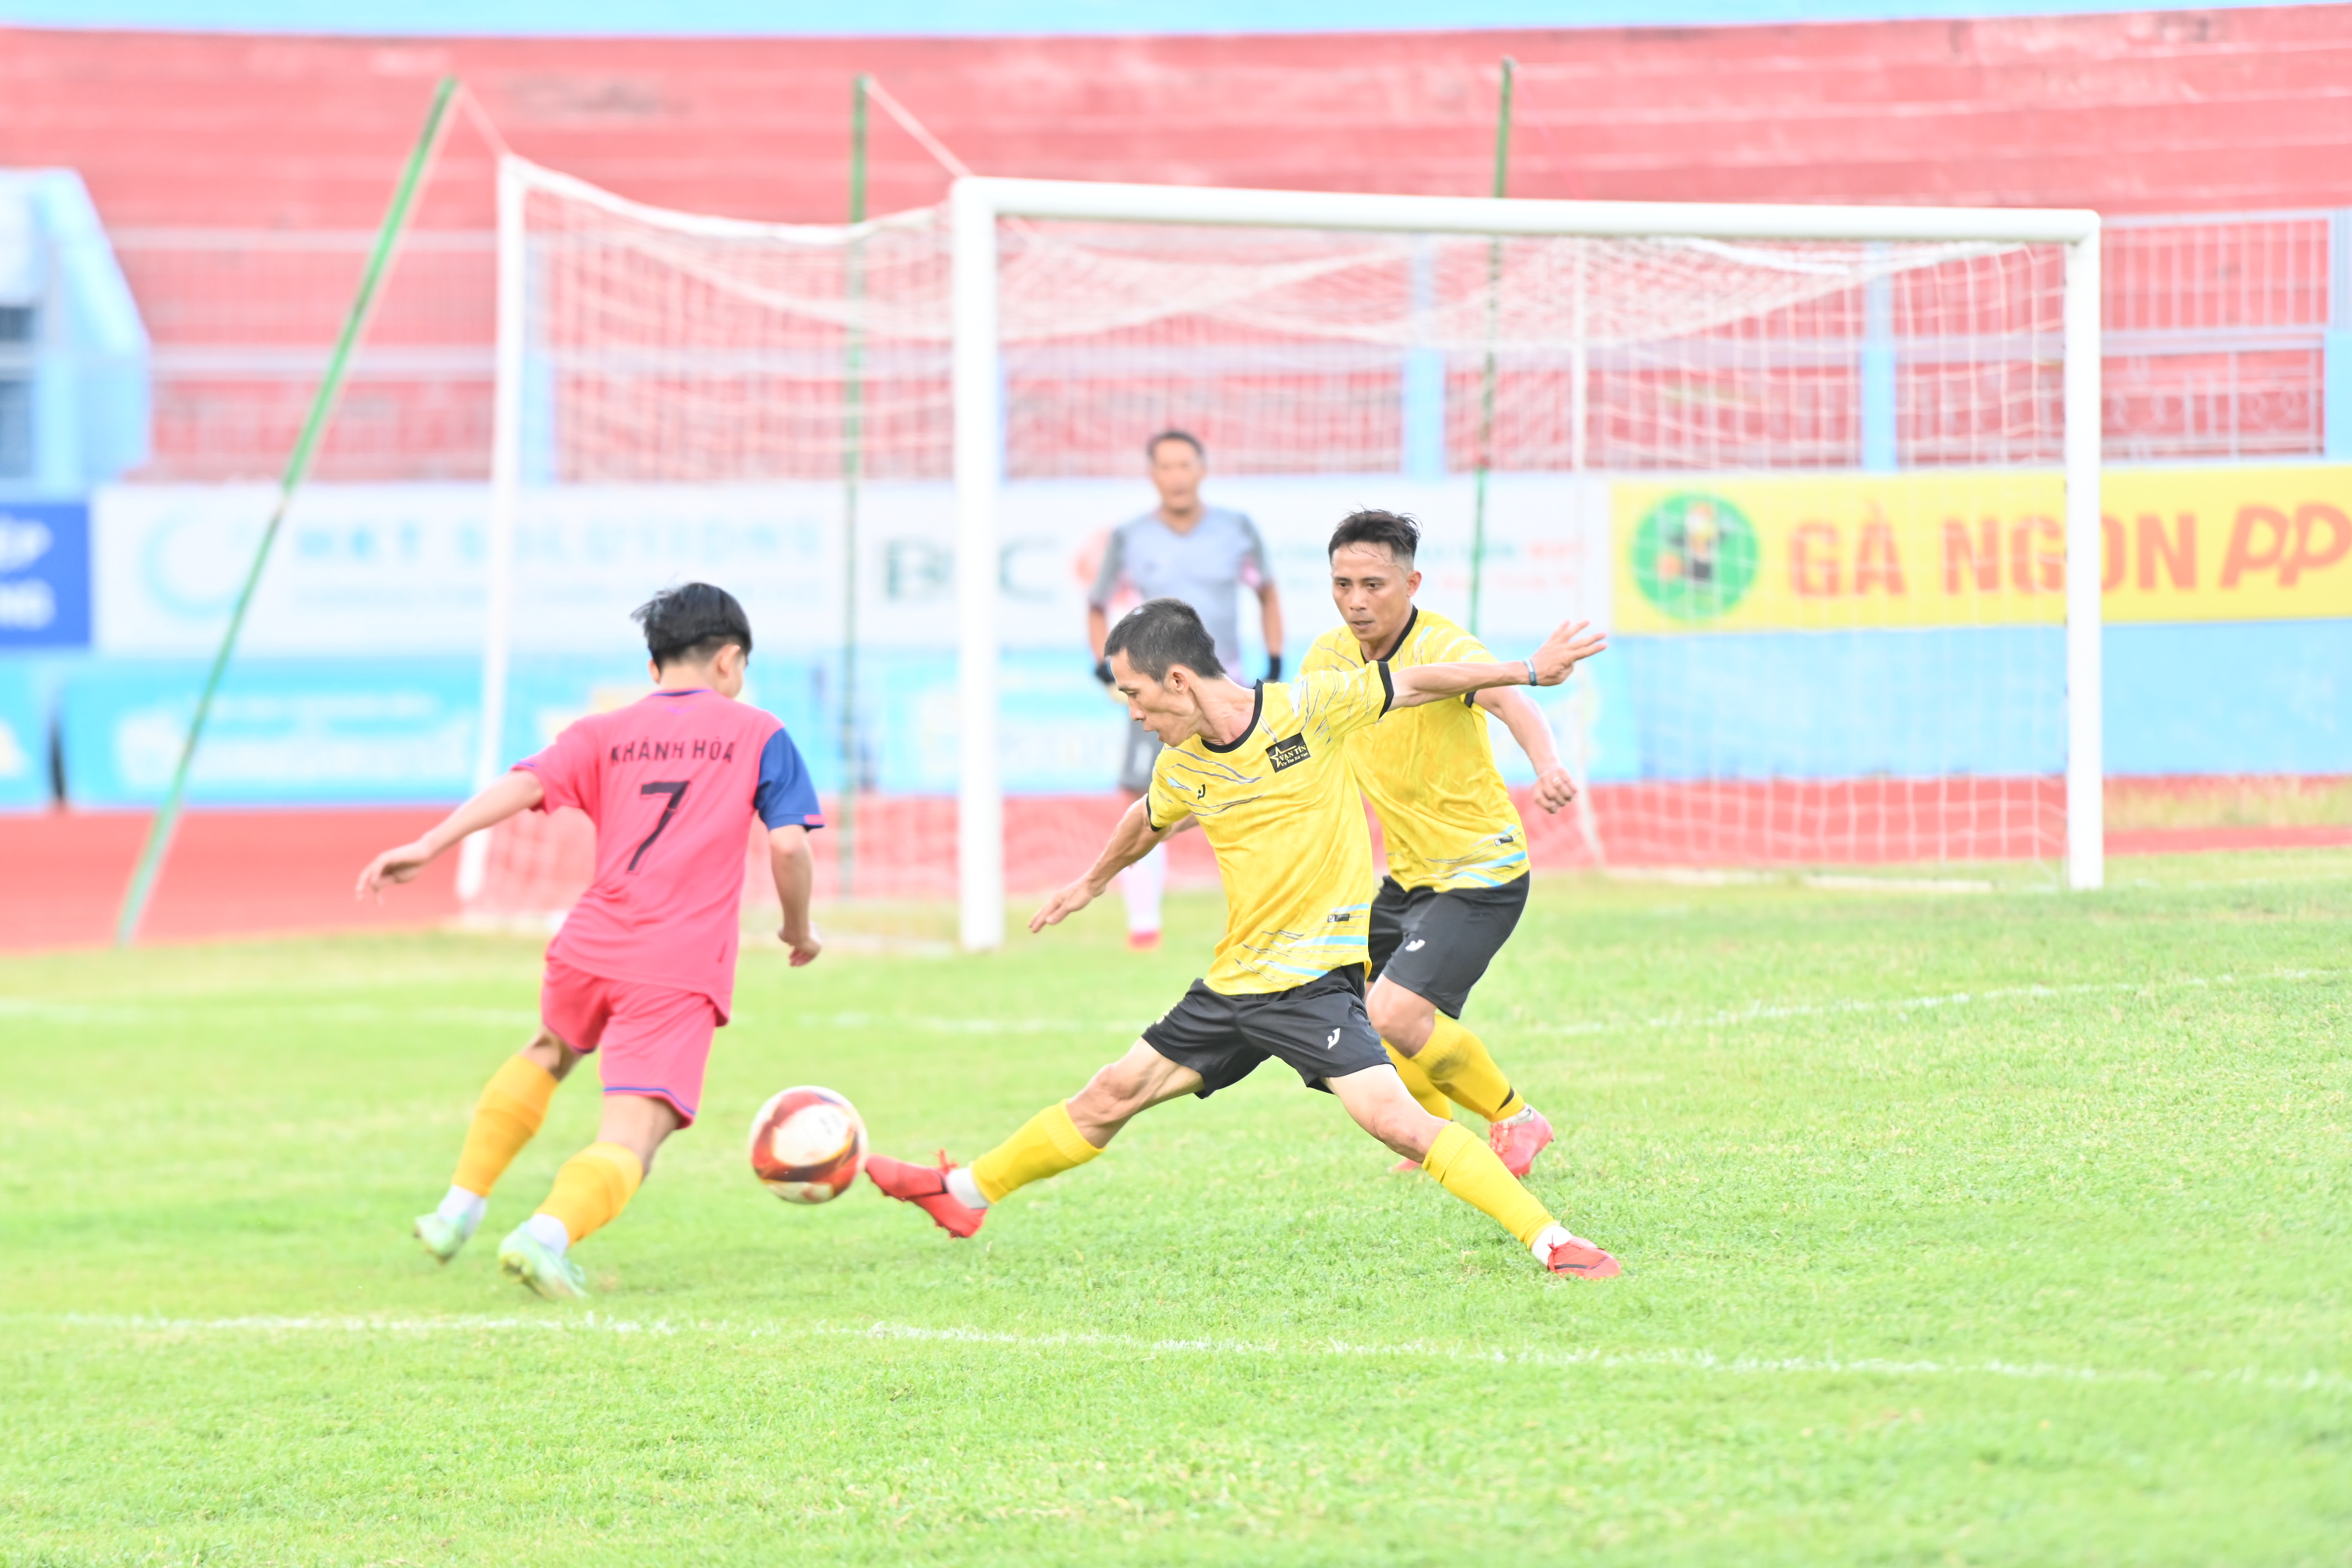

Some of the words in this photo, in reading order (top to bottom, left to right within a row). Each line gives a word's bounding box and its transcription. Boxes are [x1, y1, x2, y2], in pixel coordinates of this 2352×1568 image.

[1790, 500, 1905, 597] GÀ
[2218, 502, 2352, 589] PP
[611, 736, 686, 766] KHÁNH
[691, 736, 736, 763] HÒA
[1279, 750, 1294, 761] VẠN
[1293, 744, 1307, 754] TÍN
[626, 780, 691, 873] 7
